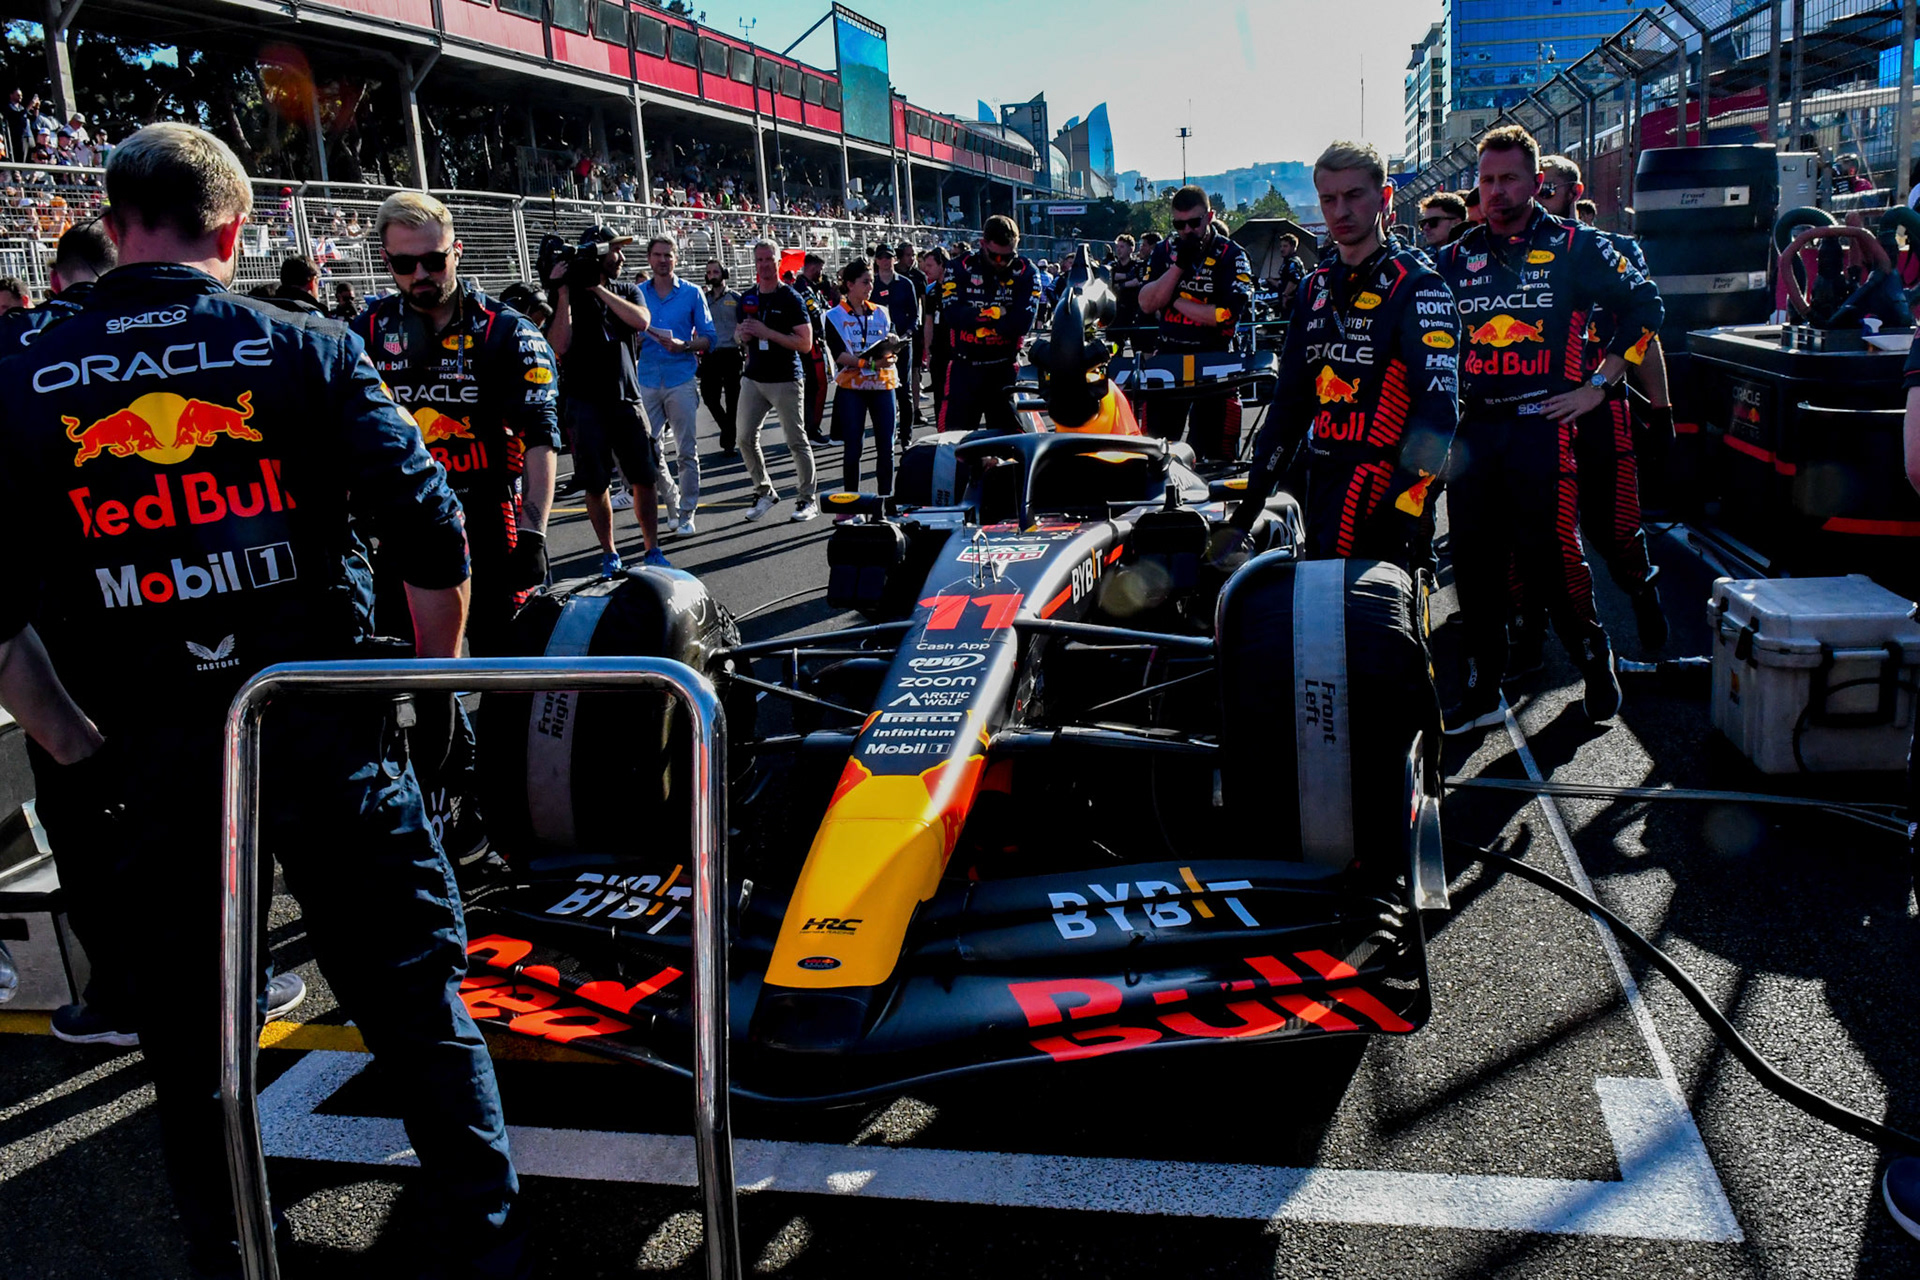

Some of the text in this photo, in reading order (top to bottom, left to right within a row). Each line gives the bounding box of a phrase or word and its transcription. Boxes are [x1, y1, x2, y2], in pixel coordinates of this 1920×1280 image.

[1460, 276, 1482, 288] Mobil
[1524, 269, 1550, 280] YBIT
[1179, 280, 1214, 293] ACLE
[1416, 302, 1453, 316] ROKT
[1458, 293, 1554, 315] ORACLE
[106, 309, 187, 334] sparco
[33, 336, 273, 393] ORACLE
[1465, 349, 1551, 376] Red Bull
[389, 384, 479, 403] RACLE
[1318, 410, 1365, 441] Bull
[429, 441, 488, 473] Bull
[95, 551, 242, 608] Mobil
[1071, 547, 1103, 605] BYBIT
[918, 594, 1025, 630] 11
[916, 643, 991, 653] Cash App
[196, 658, 240, 671] CASTORE
[897, 676, 977, 688] zoom
[920, 691, 970, 699] ARCTIC
[924, 698, 964, 706] WOLF
[1305, 678, 1321, 728] Left
[538, 691, 555, 736] Fron
[550, 693, 569, 741] Righ
[880, 711, 963, 723] PIRELLI
[1321, 681, 1337, 746] Front
[873, 728, 956, 738] infinitum
[865, 743, 927, 755] Mobil
[545, 864, 693, 936] BYBIT
[1048, 866, 1260, 940] BYBIT
[801, 917, 864, 931] HRC
[1008, 949, 1416, 1062] Bull
